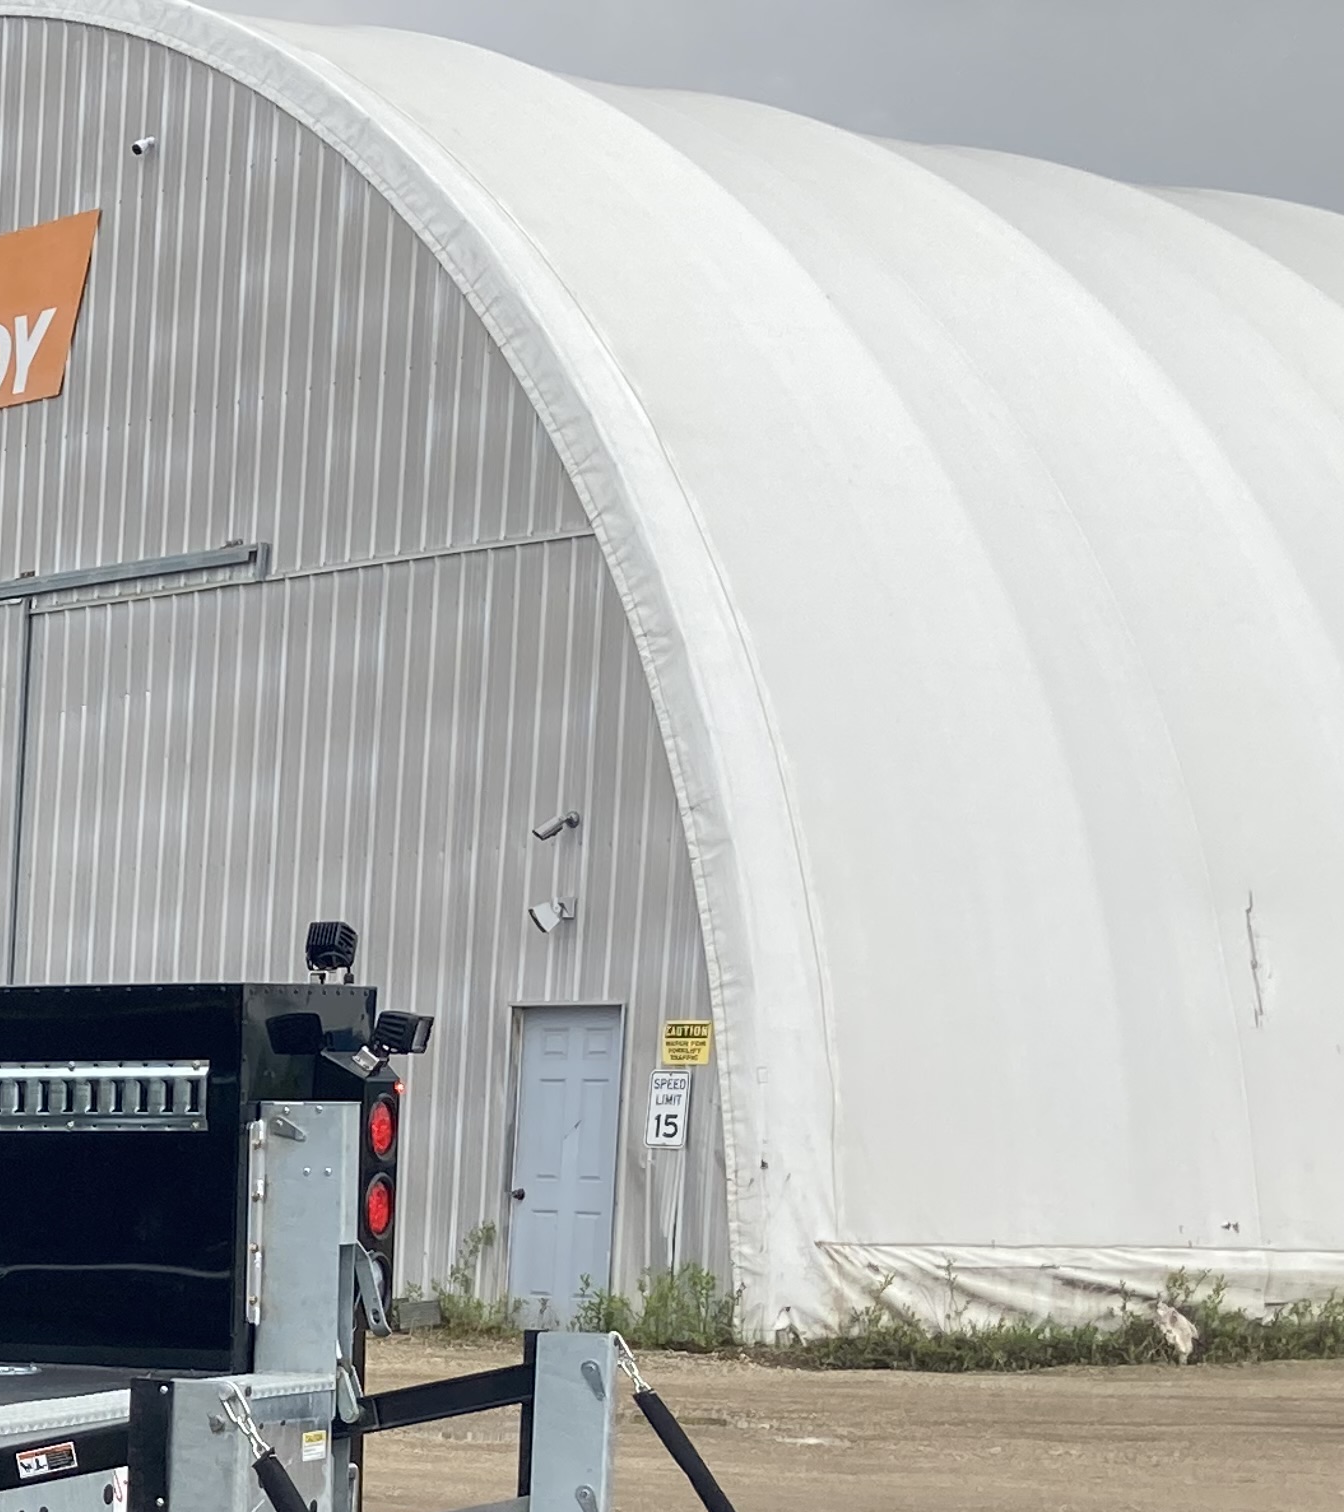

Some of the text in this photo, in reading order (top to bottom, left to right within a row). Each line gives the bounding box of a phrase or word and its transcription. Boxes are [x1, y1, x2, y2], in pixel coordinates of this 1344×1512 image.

[665, 1025, 708, 1037] CAUTION
[654, 1079, 686, 1089] SPEED
[656, 1094, 682, 1105] LIMIT
[654, 1113, 678, 1138] 15
